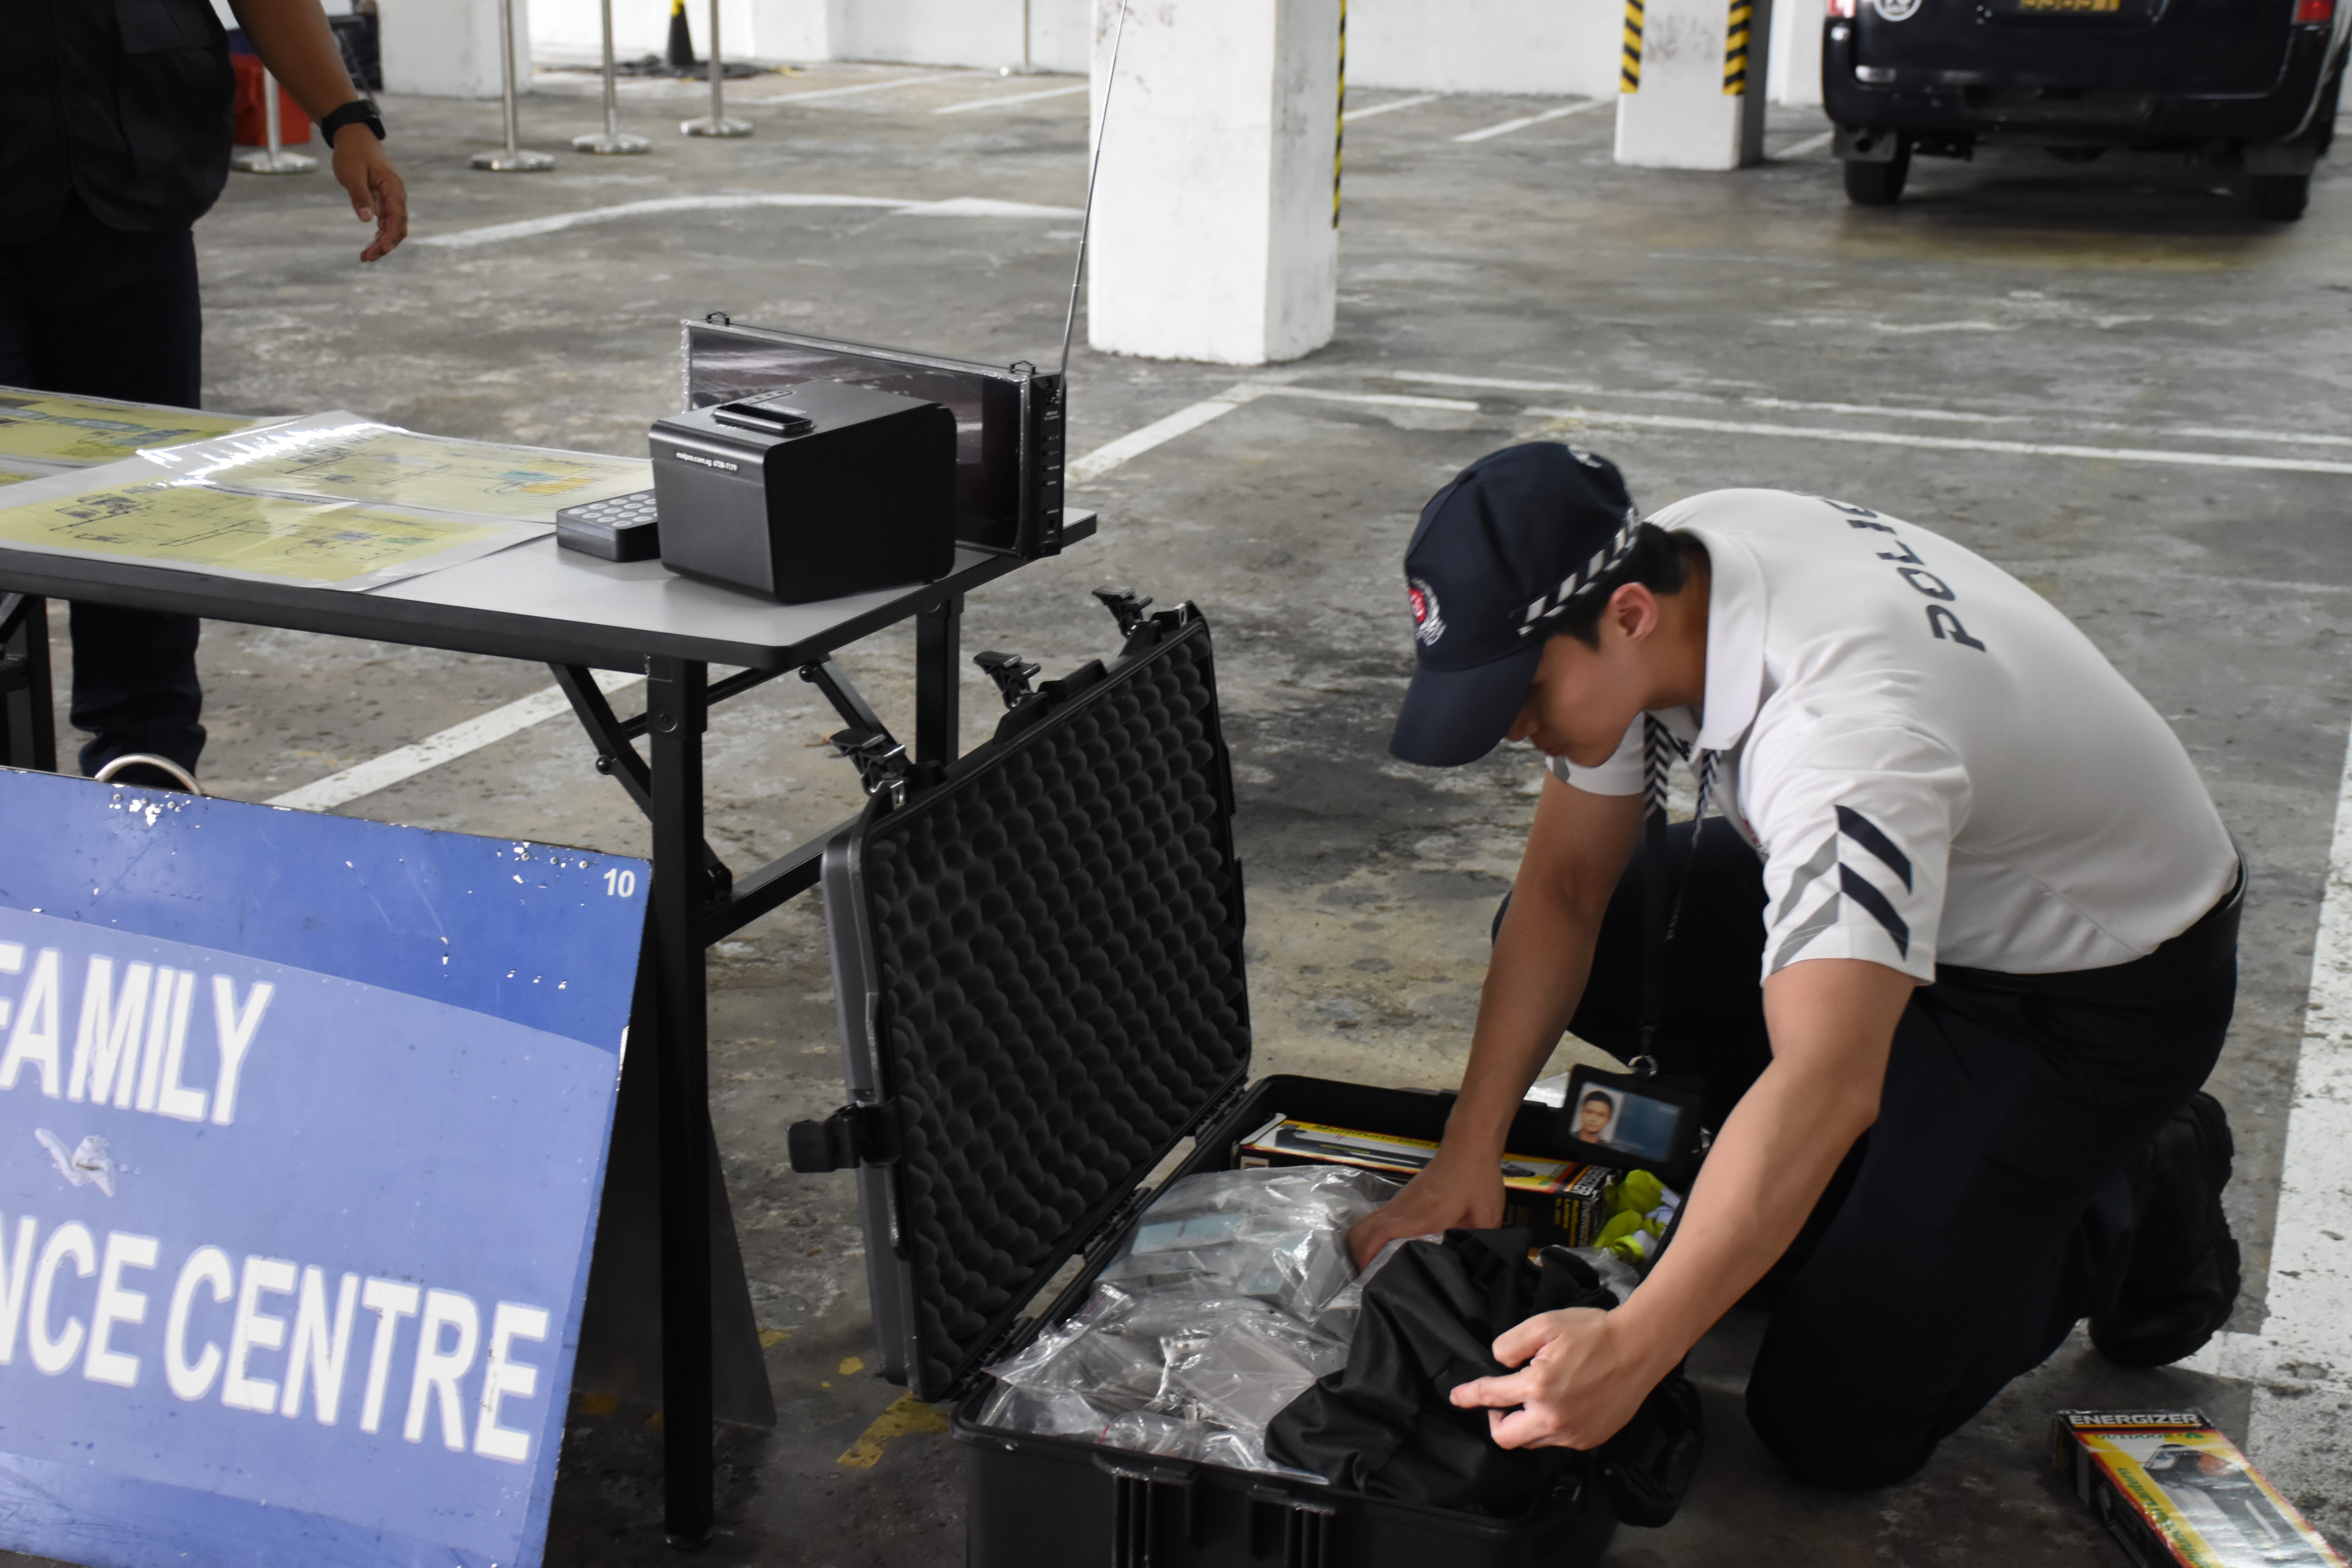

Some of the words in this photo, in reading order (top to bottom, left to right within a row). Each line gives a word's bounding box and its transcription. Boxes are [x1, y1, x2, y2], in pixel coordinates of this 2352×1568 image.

[604, 868, 635, 897] 10
[0, 943, 274, 1123] FAMILY
[165, 1246, 549, 1464] CENTRE
[2069, 1414, 2201, 1425] ENERGIZER
